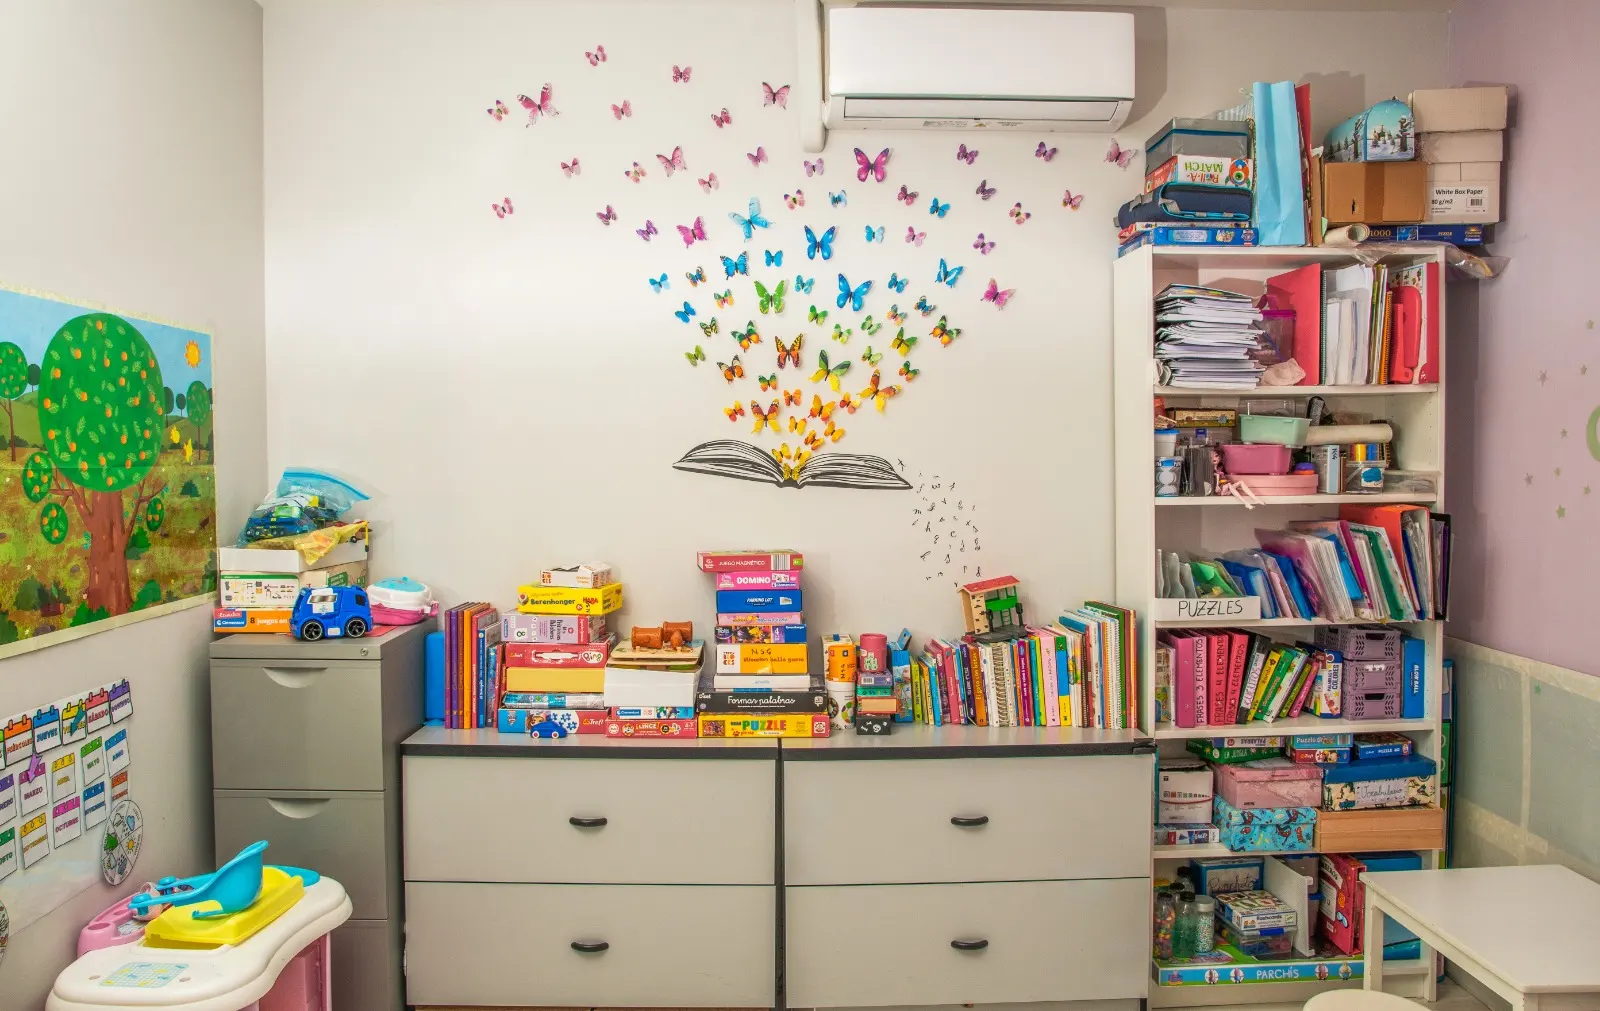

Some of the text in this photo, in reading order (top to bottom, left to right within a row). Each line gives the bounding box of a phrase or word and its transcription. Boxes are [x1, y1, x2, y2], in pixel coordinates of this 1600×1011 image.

[1184, 161, 1224, 172] MATCH
[1466, 188, 1484, 196] Paper
[736, 576, 771, 584] DOMINO
[530, 598, 576, 606] Berenhonger
[1178, 600, 1243, 618] PUZZLES
[256, 617, 278, 626] juegos
[1195, 638, 1204, 682] ELEMENTOS
[1332, 664, 1340, 690] COLORES
[975, 681, 983, 694] gato
[727, 695, 796, 705] Formas palabras
[1196, 695, 1205, 724] FRASES
[1214, 692, 1225, 723] FRASES
[1226, 697, 1237, 723] FRASES
[742, 719, 787, 731] PUZZLE
[55, 816, 80, 833] OCTUBRE
[1256, 965, 1300, 980] PARCHÍS
